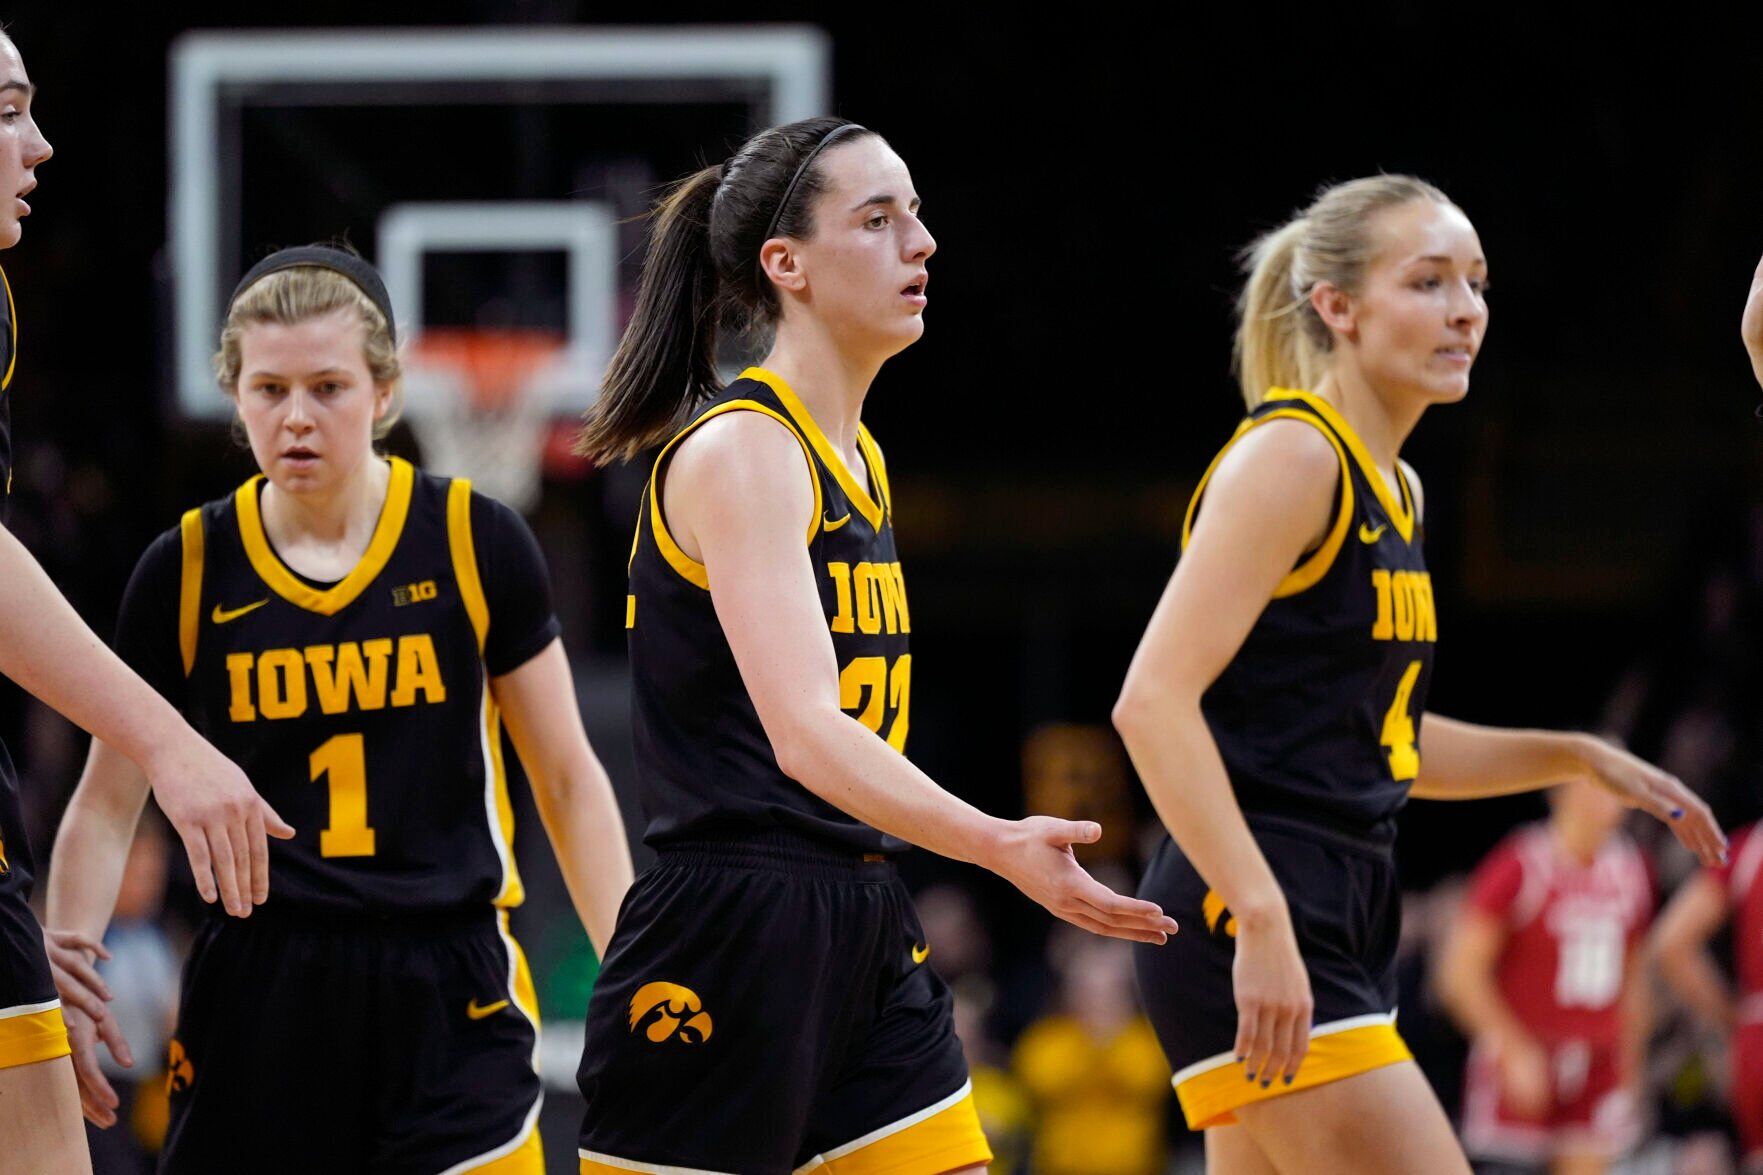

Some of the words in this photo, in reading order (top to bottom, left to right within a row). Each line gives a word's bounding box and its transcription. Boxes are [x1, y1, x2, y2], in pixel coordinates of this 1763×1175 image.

[827, 561, 911, 635] IOW
[1371, 568, 1437, 642] IOW
[226, 633, 446, 722] IOWA
[1379, 660, 1420, 782] 4
[309, 732, 376, 858] 1
